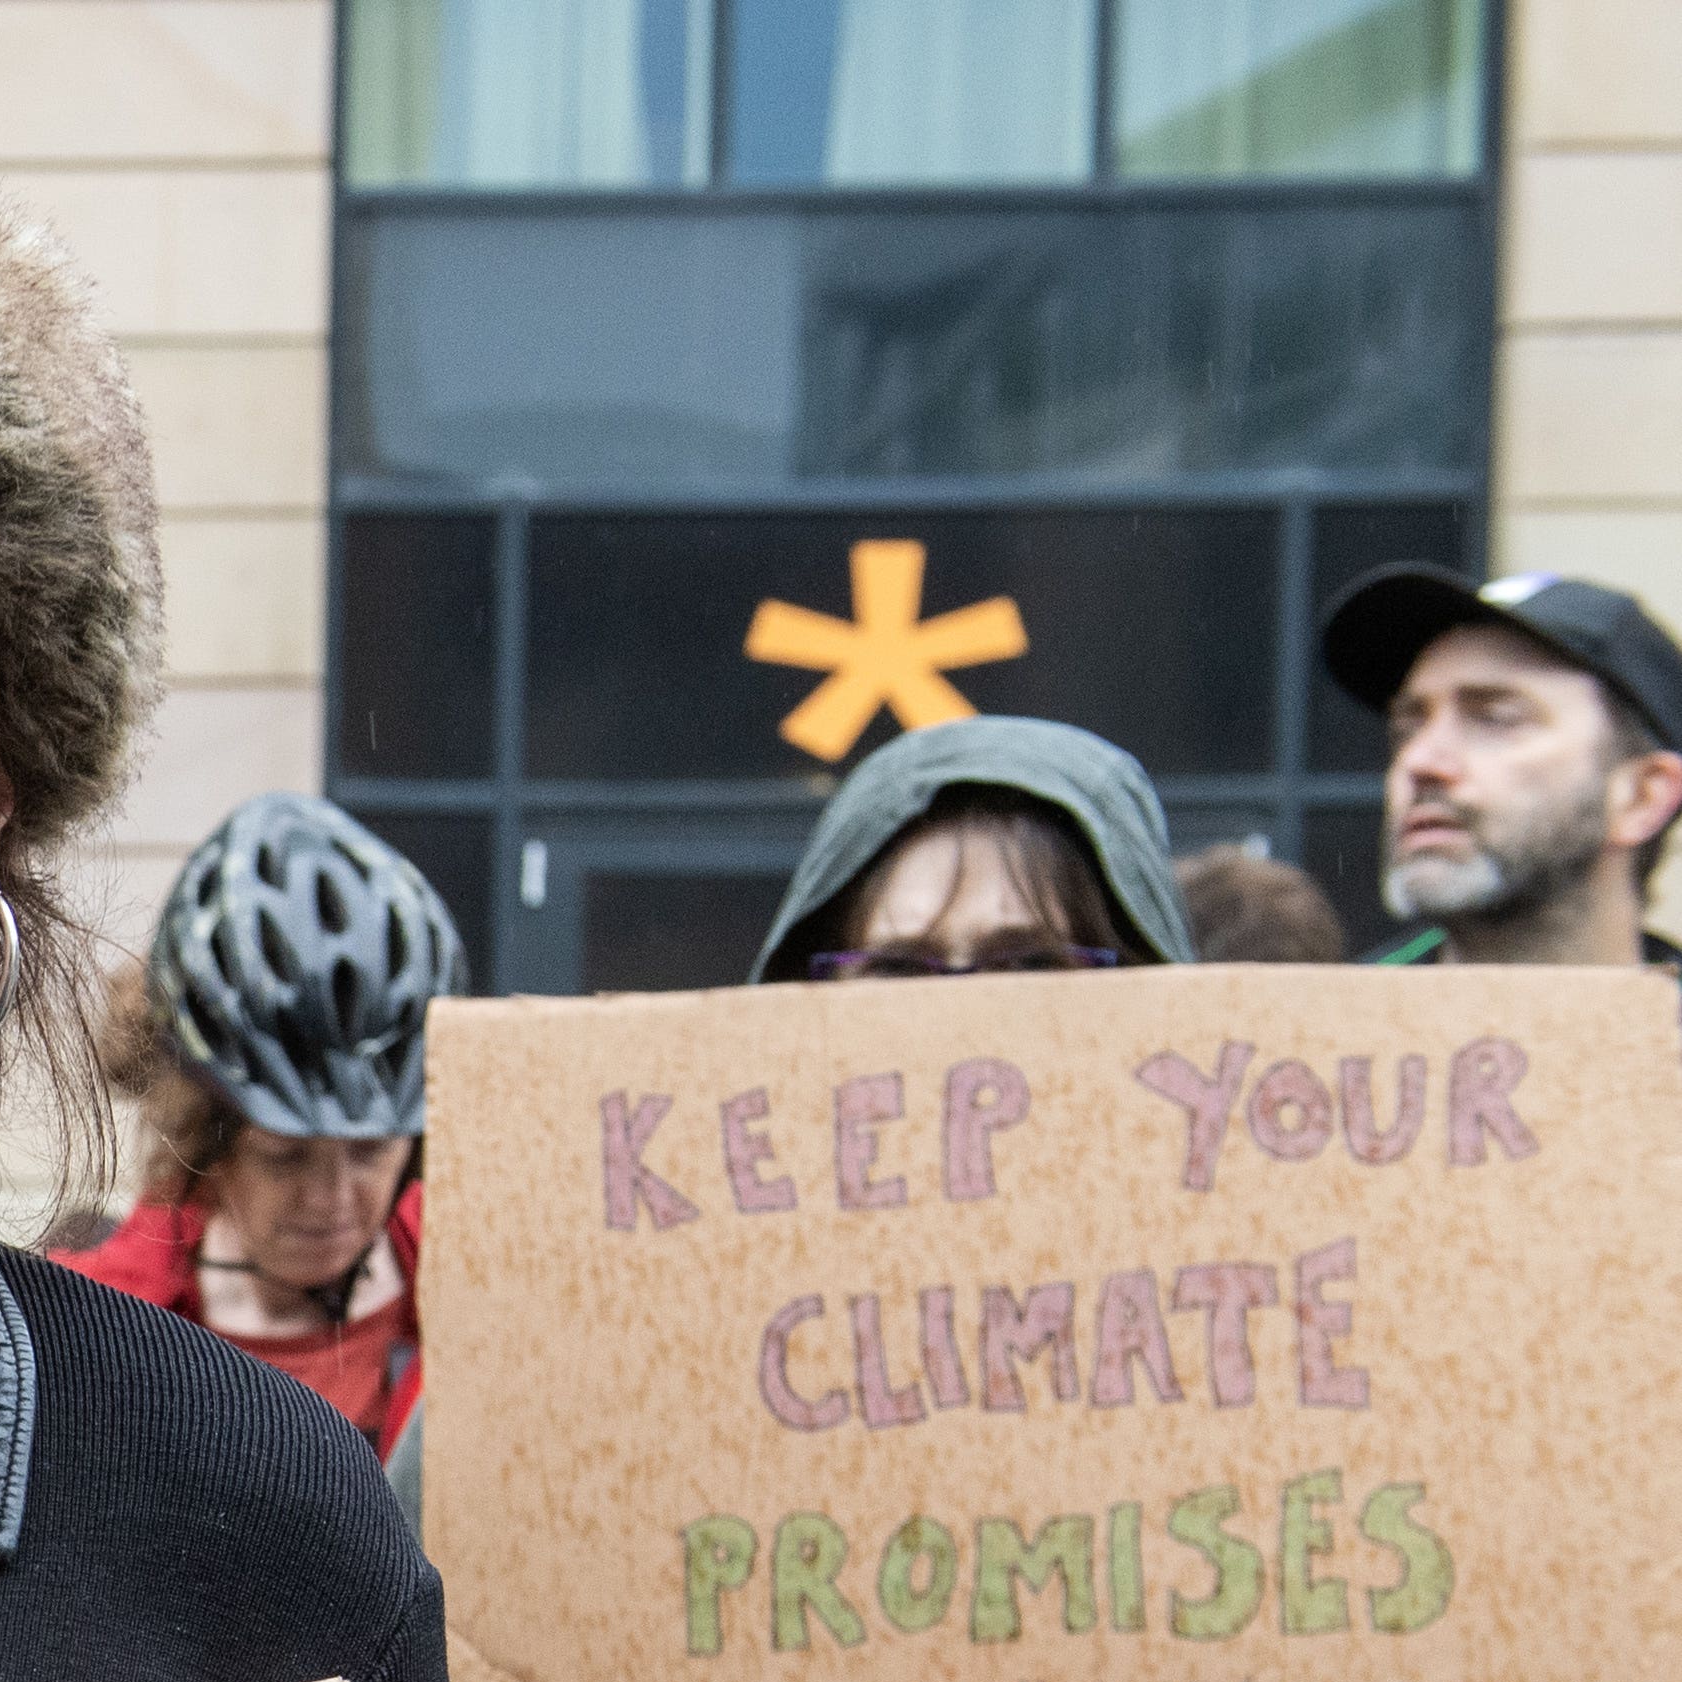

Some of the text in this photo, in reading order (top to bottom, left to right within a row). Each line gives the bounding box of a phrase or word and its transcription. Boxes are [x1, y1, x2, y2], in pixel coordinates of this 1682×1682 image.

[600, 1037, 1541, 1233] KEEP YOUR
[757, 1238, 1373, 1433] CLIMATE
[679, 1469, 1456, 1658] PROMISES
